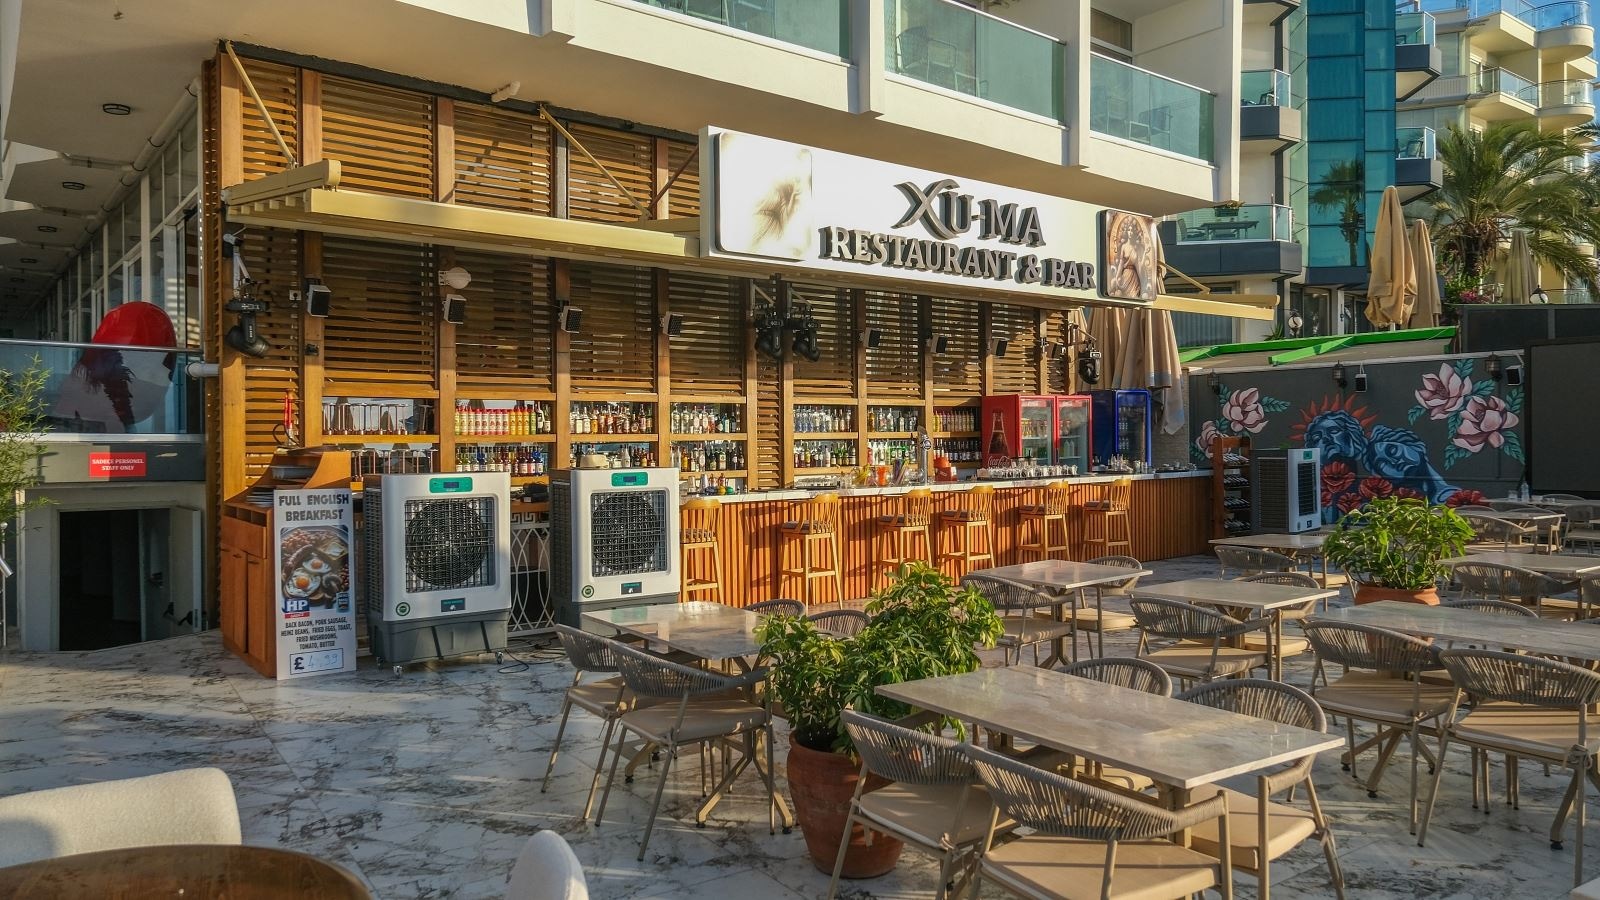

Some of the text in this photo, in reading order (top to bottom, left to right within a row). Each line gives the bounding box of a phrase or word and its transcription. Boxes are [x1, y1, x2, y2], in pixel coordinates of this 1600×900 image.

[890, 179, 1046, 248] XU-MA
[818, 226, 1096, 290] RESTAURANT & BAR
[278, 494, 349, 506] FULL ENGLISH
[285, 509, 344, 522] BREAKFAST
[286, 600, 308, 612] HP
[293, 656, 305, 670] £
